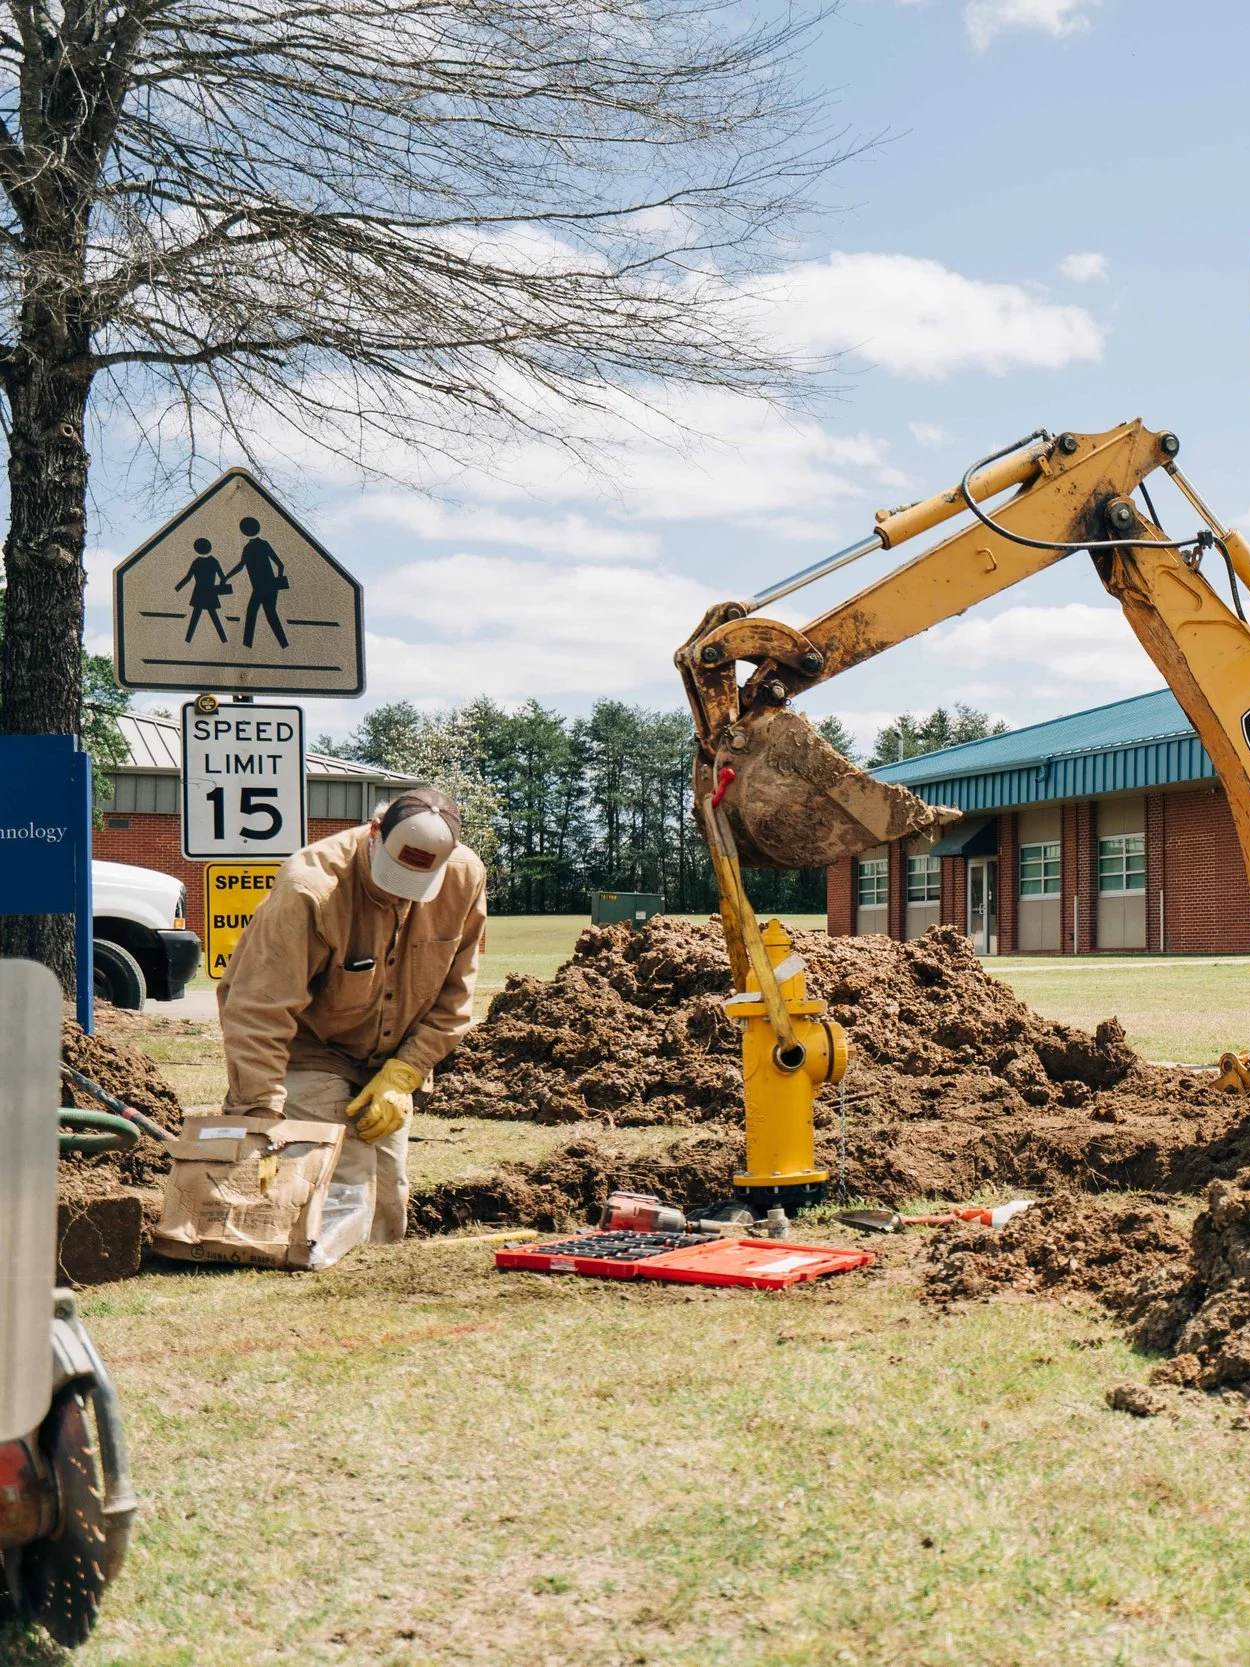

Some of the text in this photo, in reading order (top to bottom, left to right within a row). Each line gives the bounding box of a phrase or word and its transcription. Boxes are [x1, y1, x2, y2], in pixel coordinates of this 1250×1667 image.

[193, 720, 294, 742] SPEED
[205, 753, 283, 775] LIMIT
[206, 787, 283, 840] 15
[0, 821, 68, 843] nology
